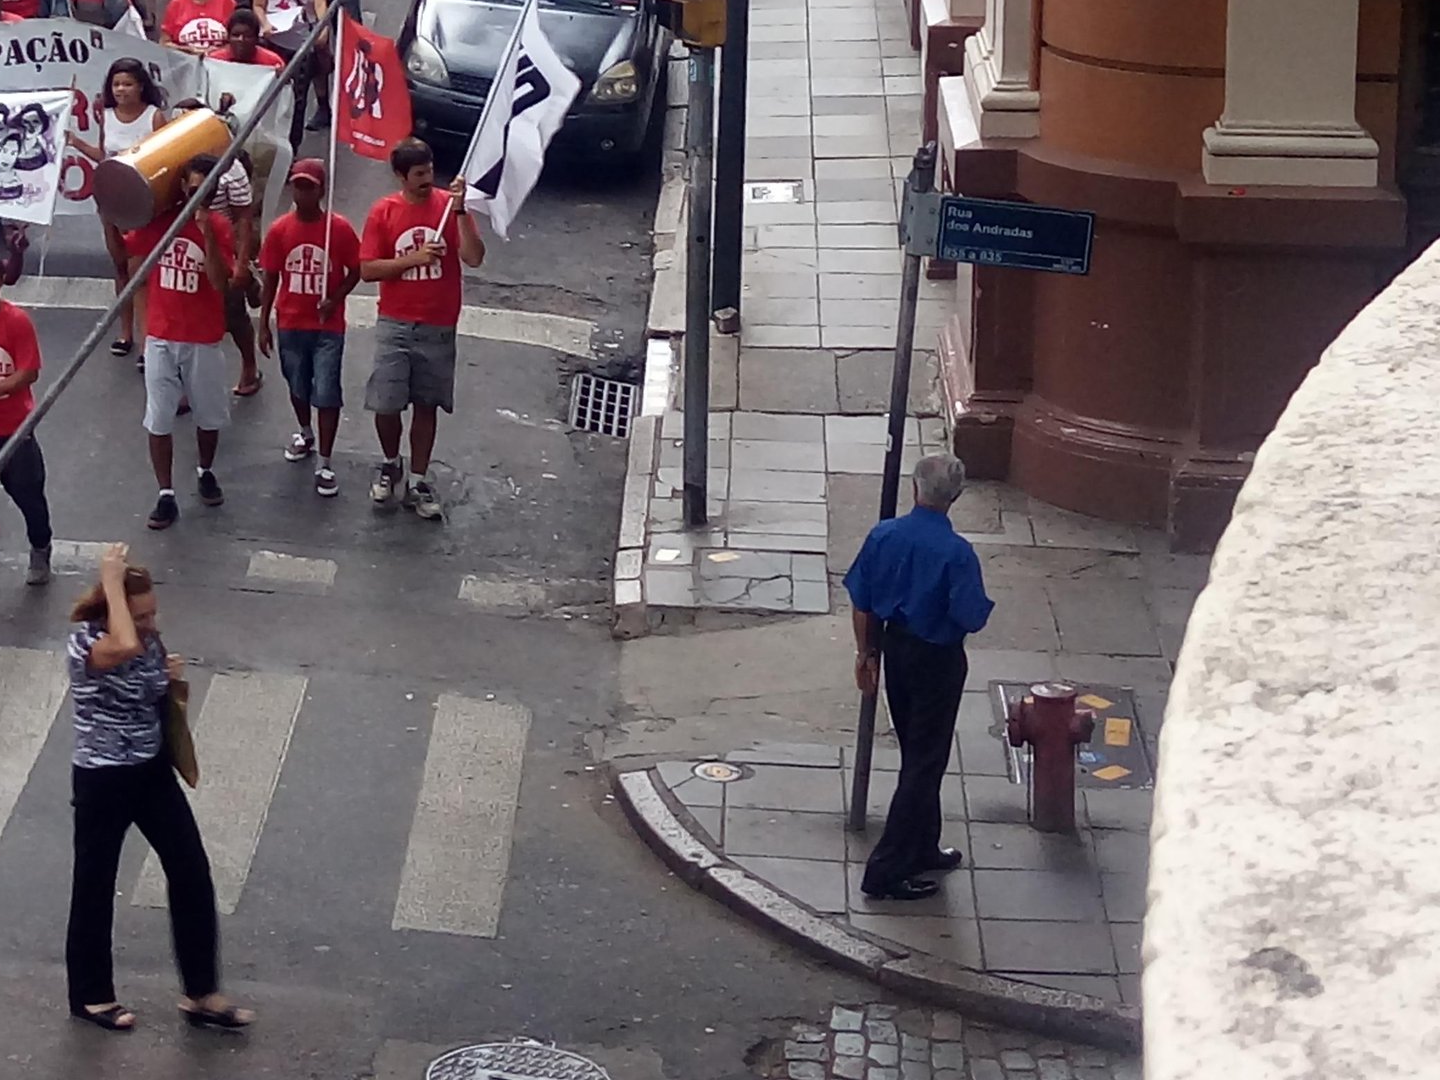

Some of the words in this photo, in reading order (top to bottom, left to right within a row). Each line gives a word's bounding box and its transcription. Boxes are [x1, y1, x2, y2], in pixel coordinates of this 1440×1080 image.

[947, 206, 973, 219] Rua
[946, 219, 969, 231] dos
[972, 222, 1034, 239] Andradas
[160, 266, 200, 294] MLB
